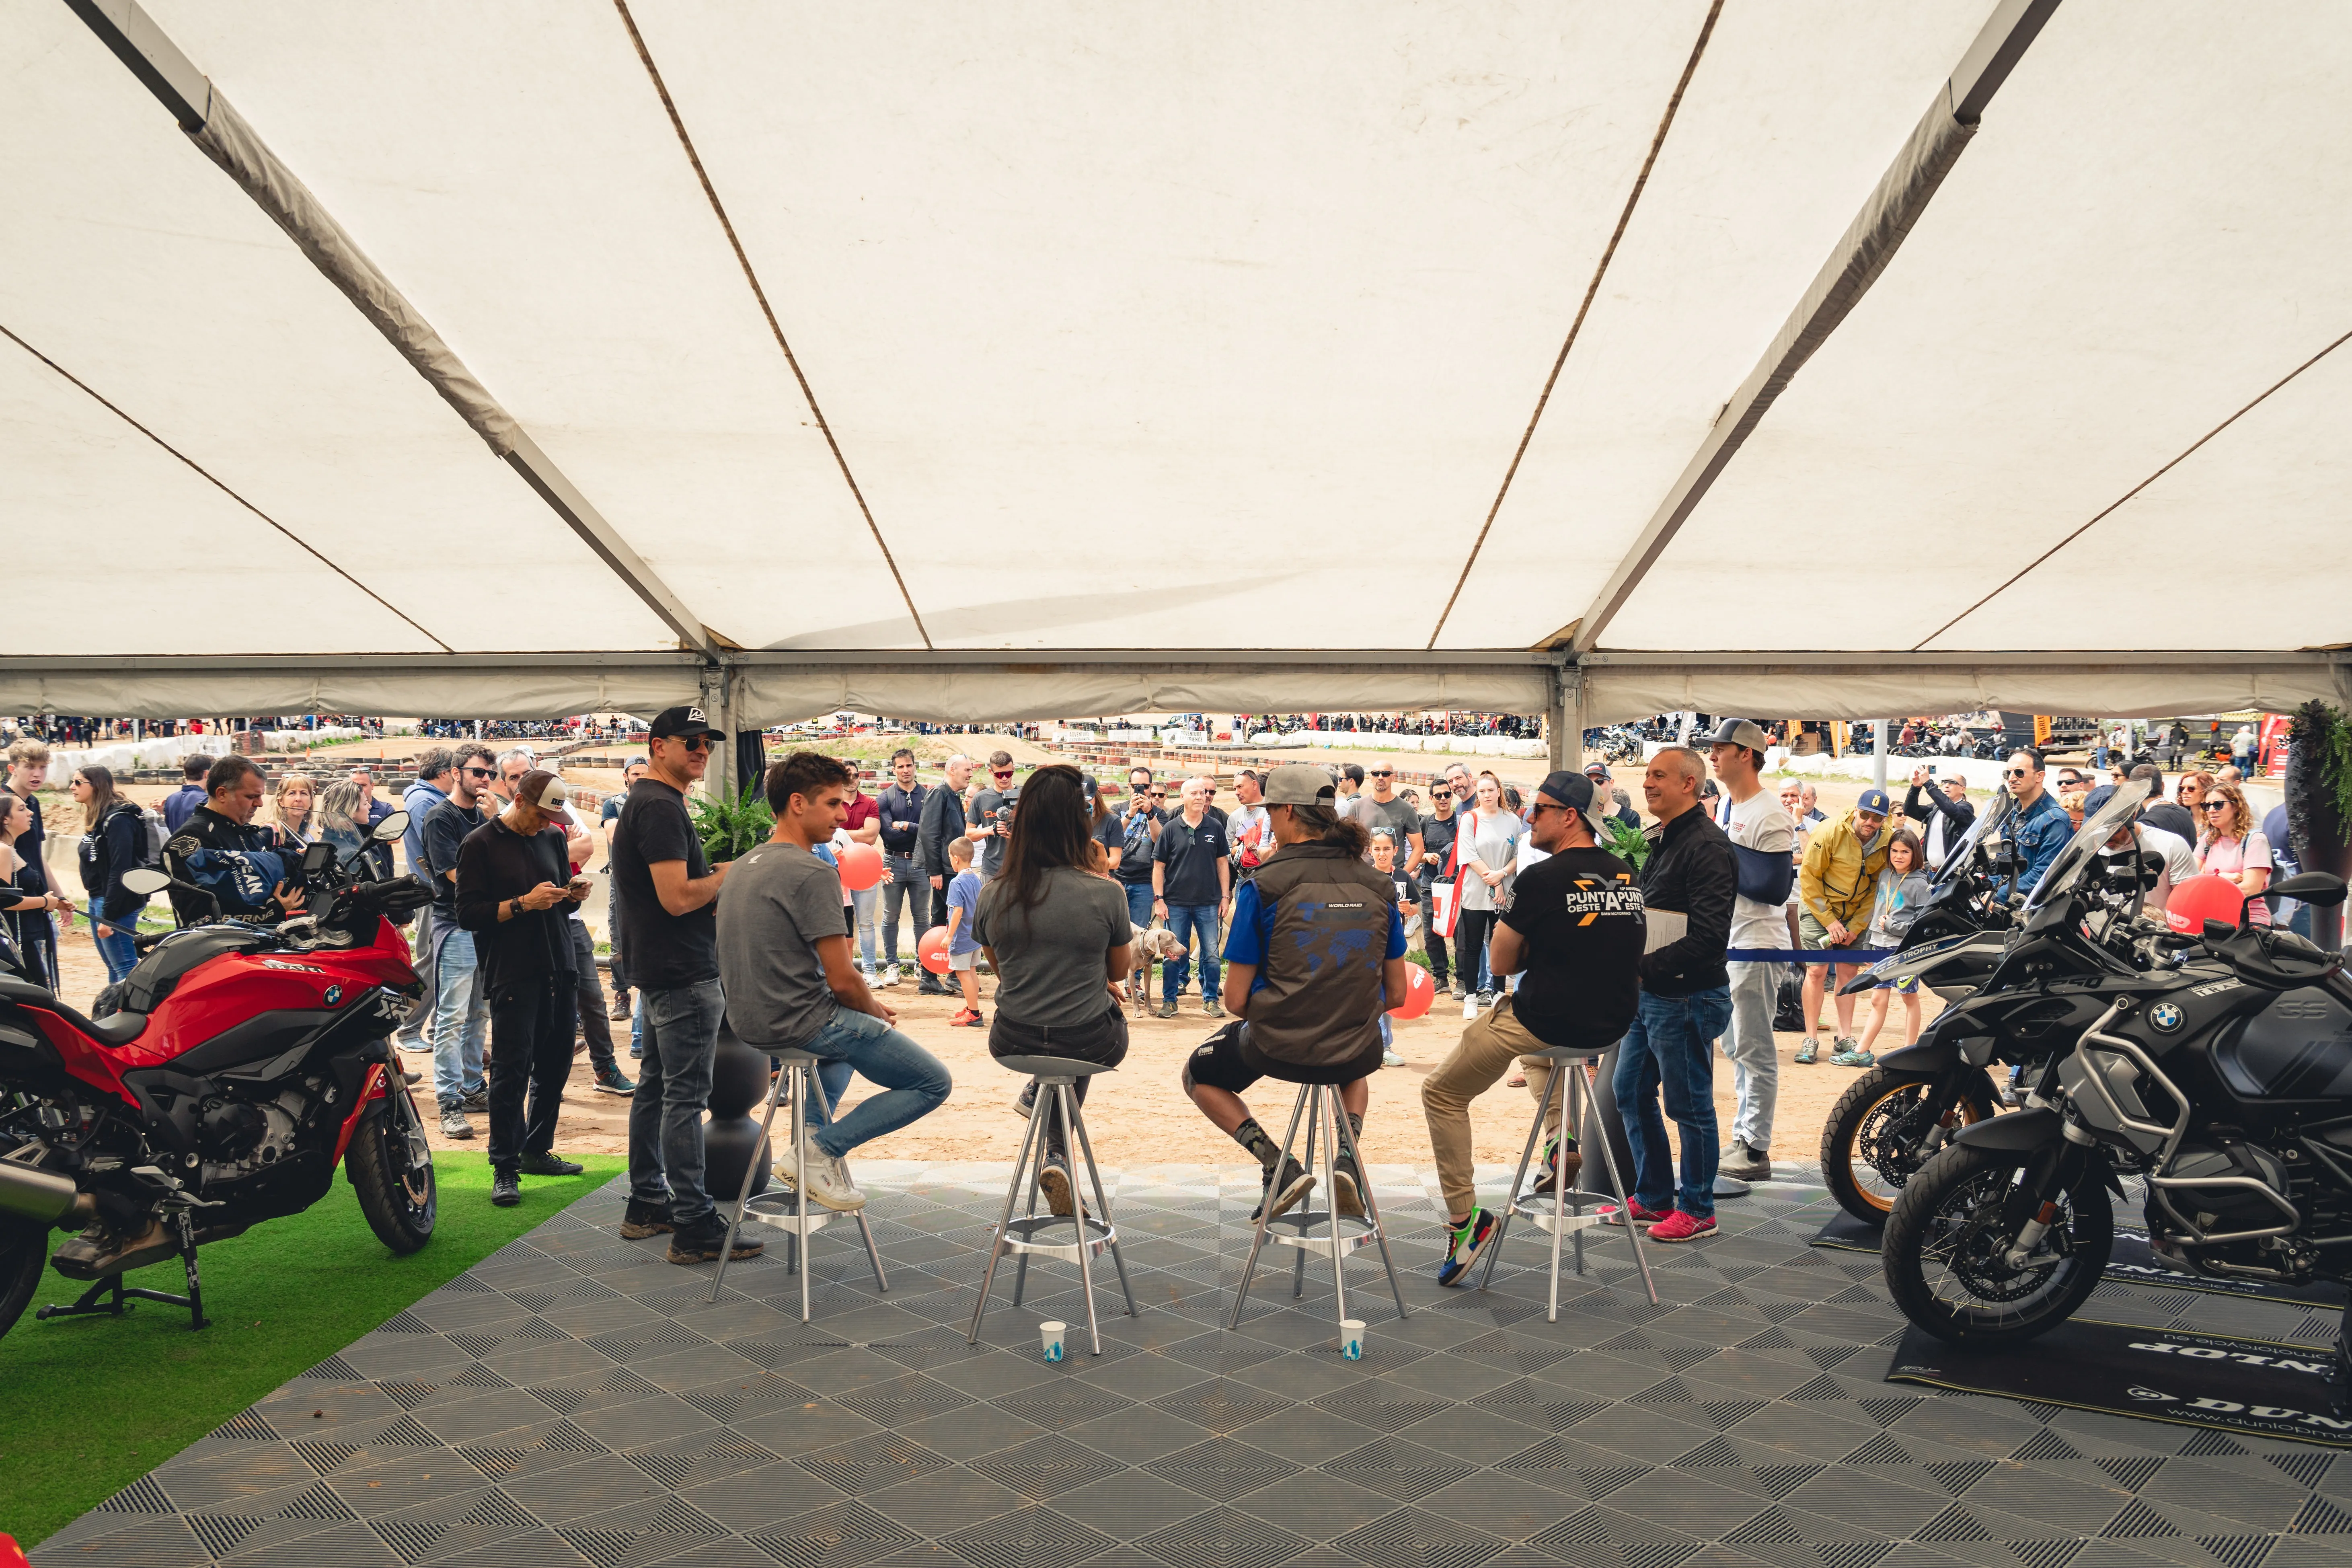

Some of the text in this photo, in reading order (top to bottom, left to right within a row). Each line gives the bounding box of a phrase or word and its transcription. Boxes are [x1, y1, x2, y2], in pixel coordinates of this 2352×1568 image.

[2038, 716, 2047, 735] HARLE
[1814, 841, 1822, 849] HH
[231, 870, 242, 884] pide
[1567, 903, 1600, 912] OESTE
[1625, 902, 1641, 910] ESTE
[222, 909, 275, 923] BERING
[931, 952, 951, 962] GIV
[1903, 943, 1938, 959] TROPHY
[265, 964, 327, 974] TRAVEL
[329, 986, 343, 994] BMW
[380, 994, 403, 1003] S1000
[372, 999, 413, 1023] XR
[2153, 1005, 2178, 1015] BMW
[2274, 1000, 2327, 1019] GS
[2059, 1229, 2068, 1252] brembo
[2186, 1397, 2352, 1429] DUN
